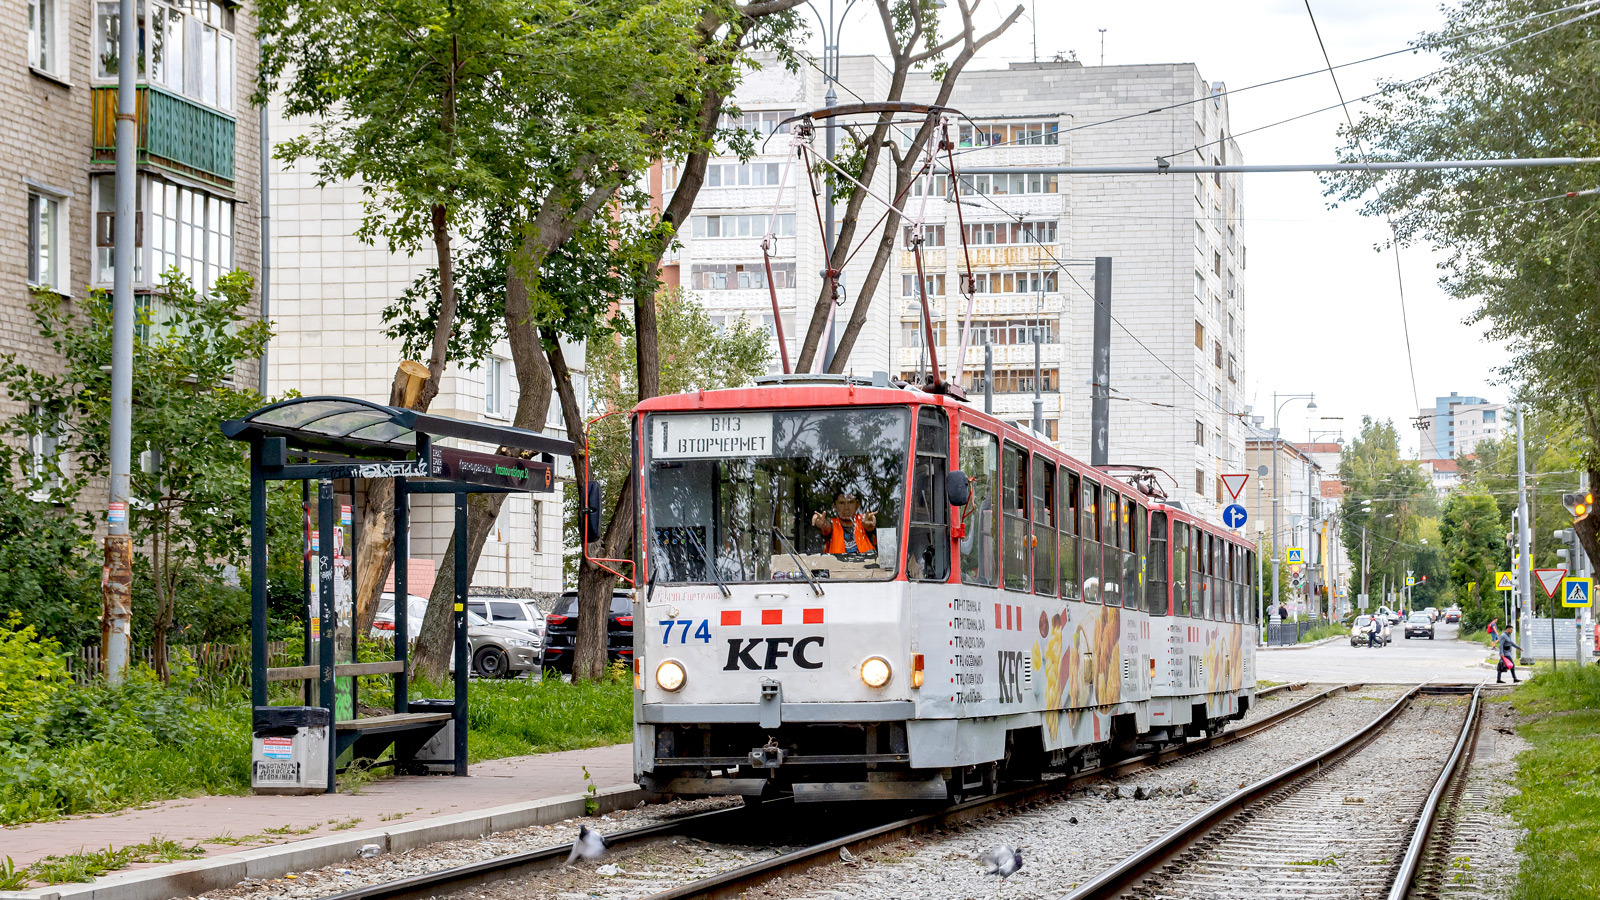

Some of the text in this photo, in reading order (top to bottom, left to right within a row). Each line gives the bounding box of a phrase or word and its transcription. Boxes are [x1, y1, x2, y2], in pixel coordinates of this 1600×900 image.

[661, 421, 669, 453] 1
[711, 417, 741, 432] ВИЗ
[678, 436, 767, 453] ВТОРЧЕРМЕТ
[659, 619, 712, 645] 774
[723, 636, 825, 672] KFC
[998, 650, 1023, 704] KFC
